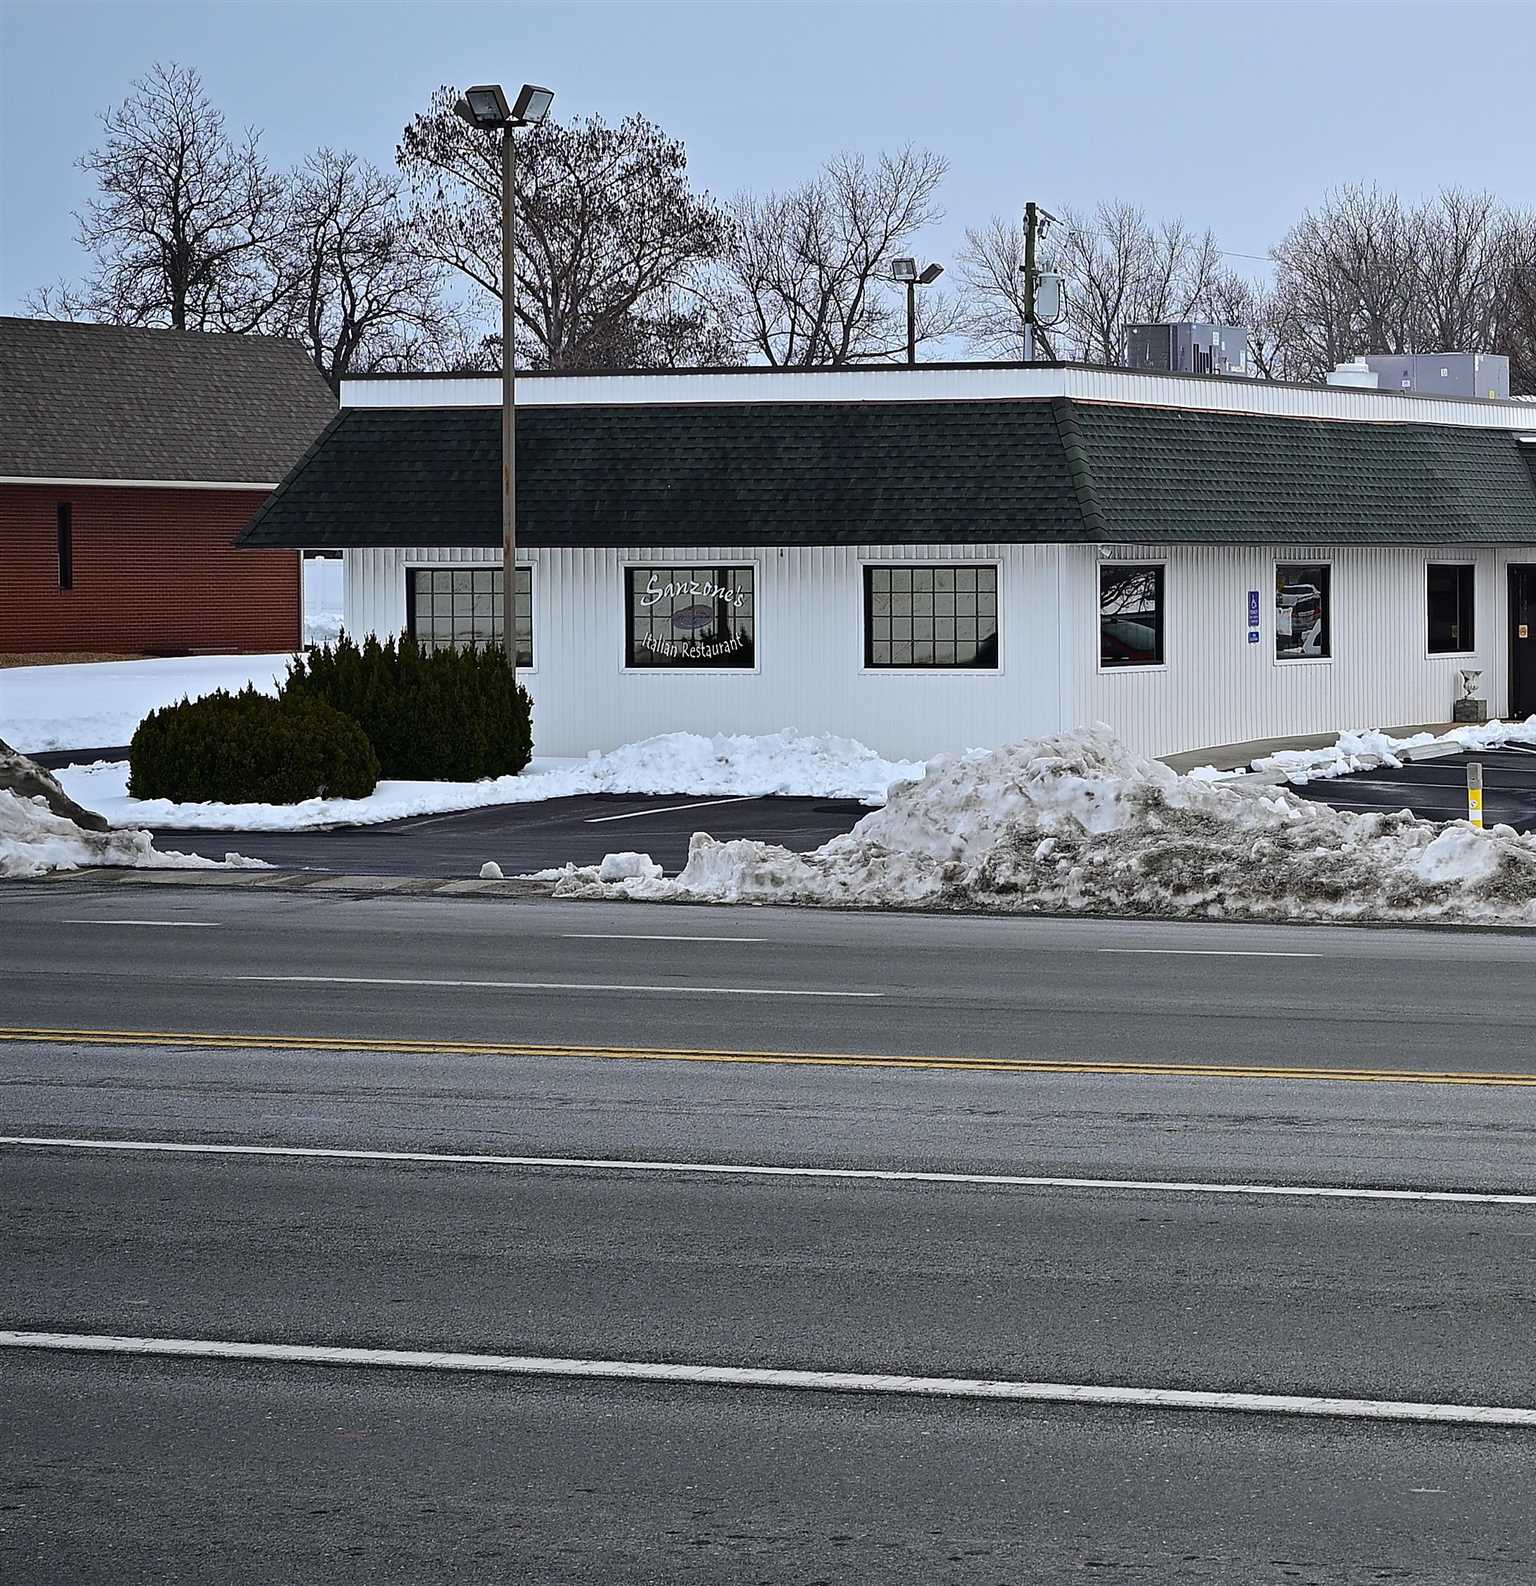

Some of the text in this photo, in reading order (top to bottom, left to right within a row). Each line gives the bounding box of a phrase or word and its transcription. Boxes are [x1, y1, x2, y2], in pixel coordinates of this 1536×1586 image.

[640, 574, 744, 607] Sanzone's
[641, 631, 744, 658] Italian Restaurant
